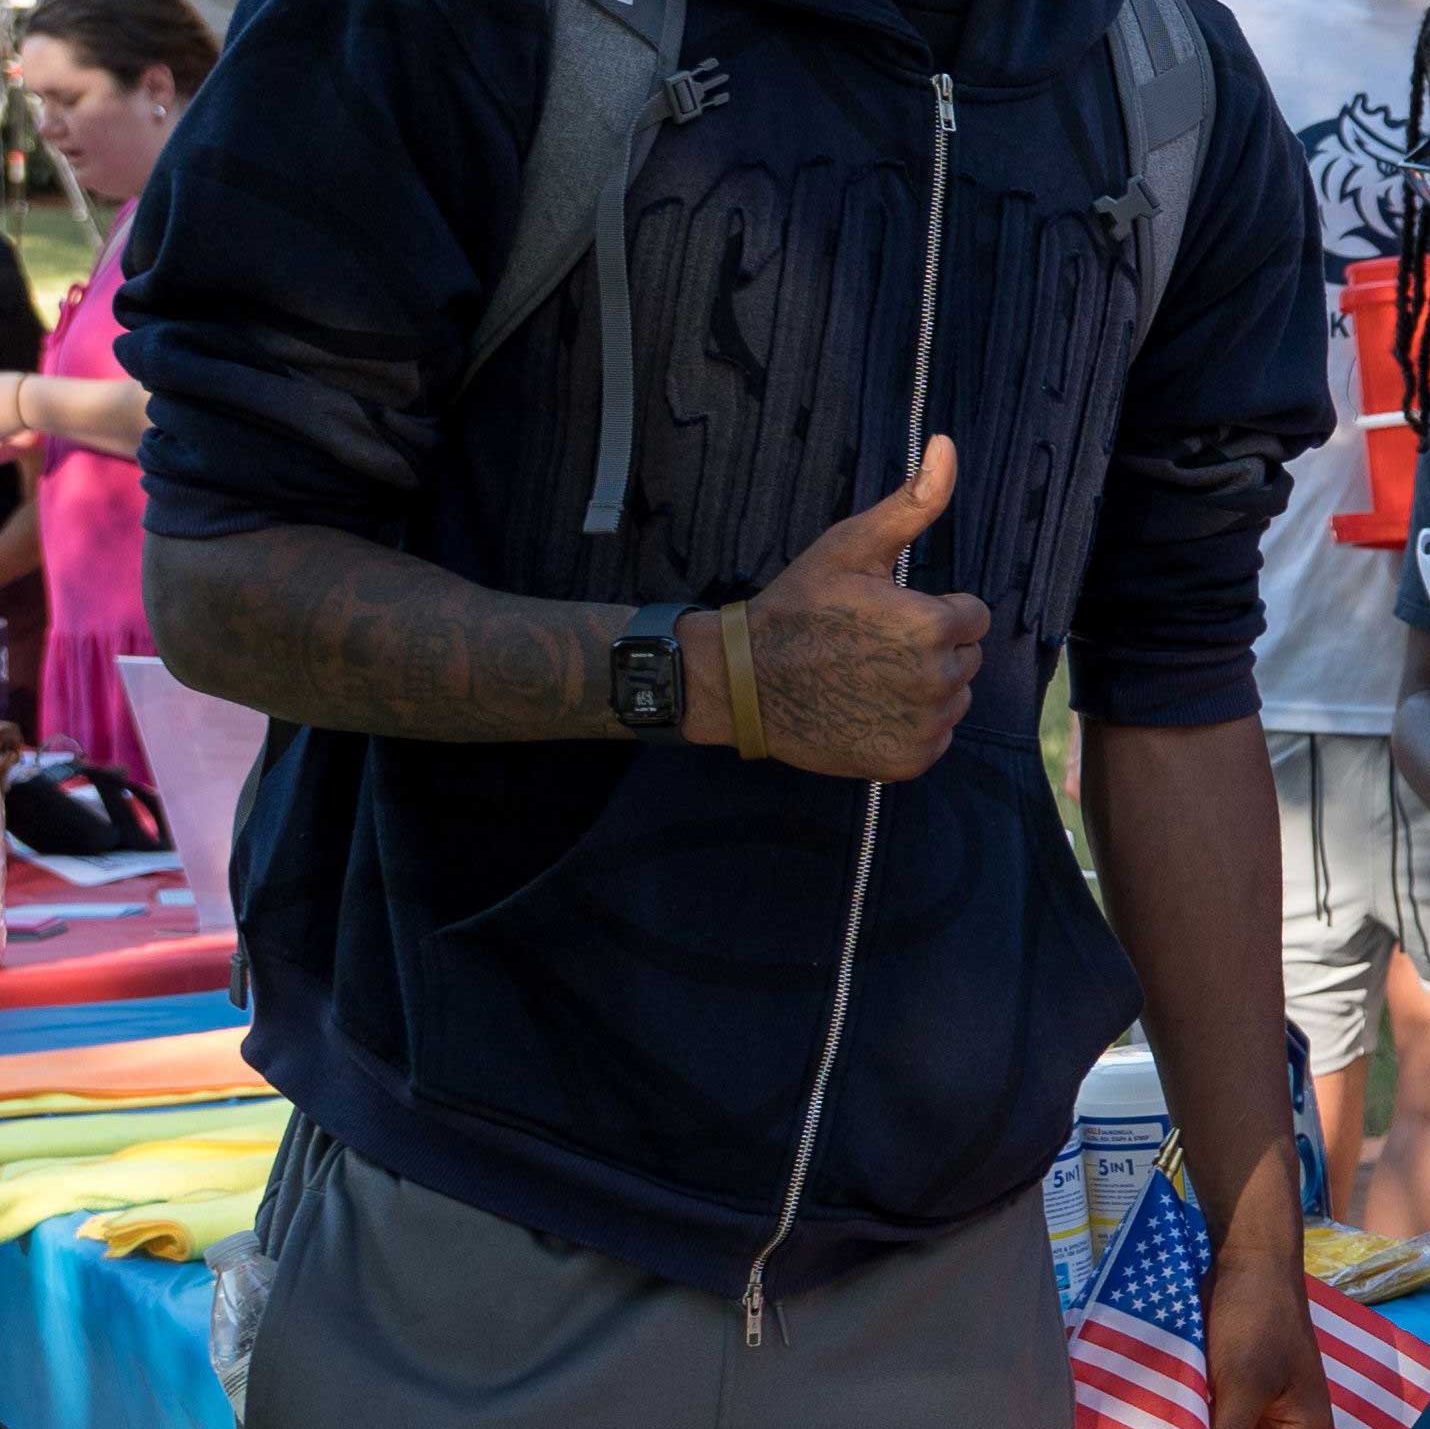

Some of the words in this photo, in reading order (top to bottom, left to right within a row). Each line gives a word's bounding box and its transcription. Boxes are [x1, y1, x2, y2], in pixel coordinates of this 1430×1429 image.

[1053, 1170, 1065, 1188] 5
[1065, 1170, 1075, 1182] IN
[1075, 1164, 1080, 1182] 1
[1098, 1159, 1109, 1176] 5
[1110, 1161, 1124, 1173] IN
[1125, 1158, 1135, 1176] 1
